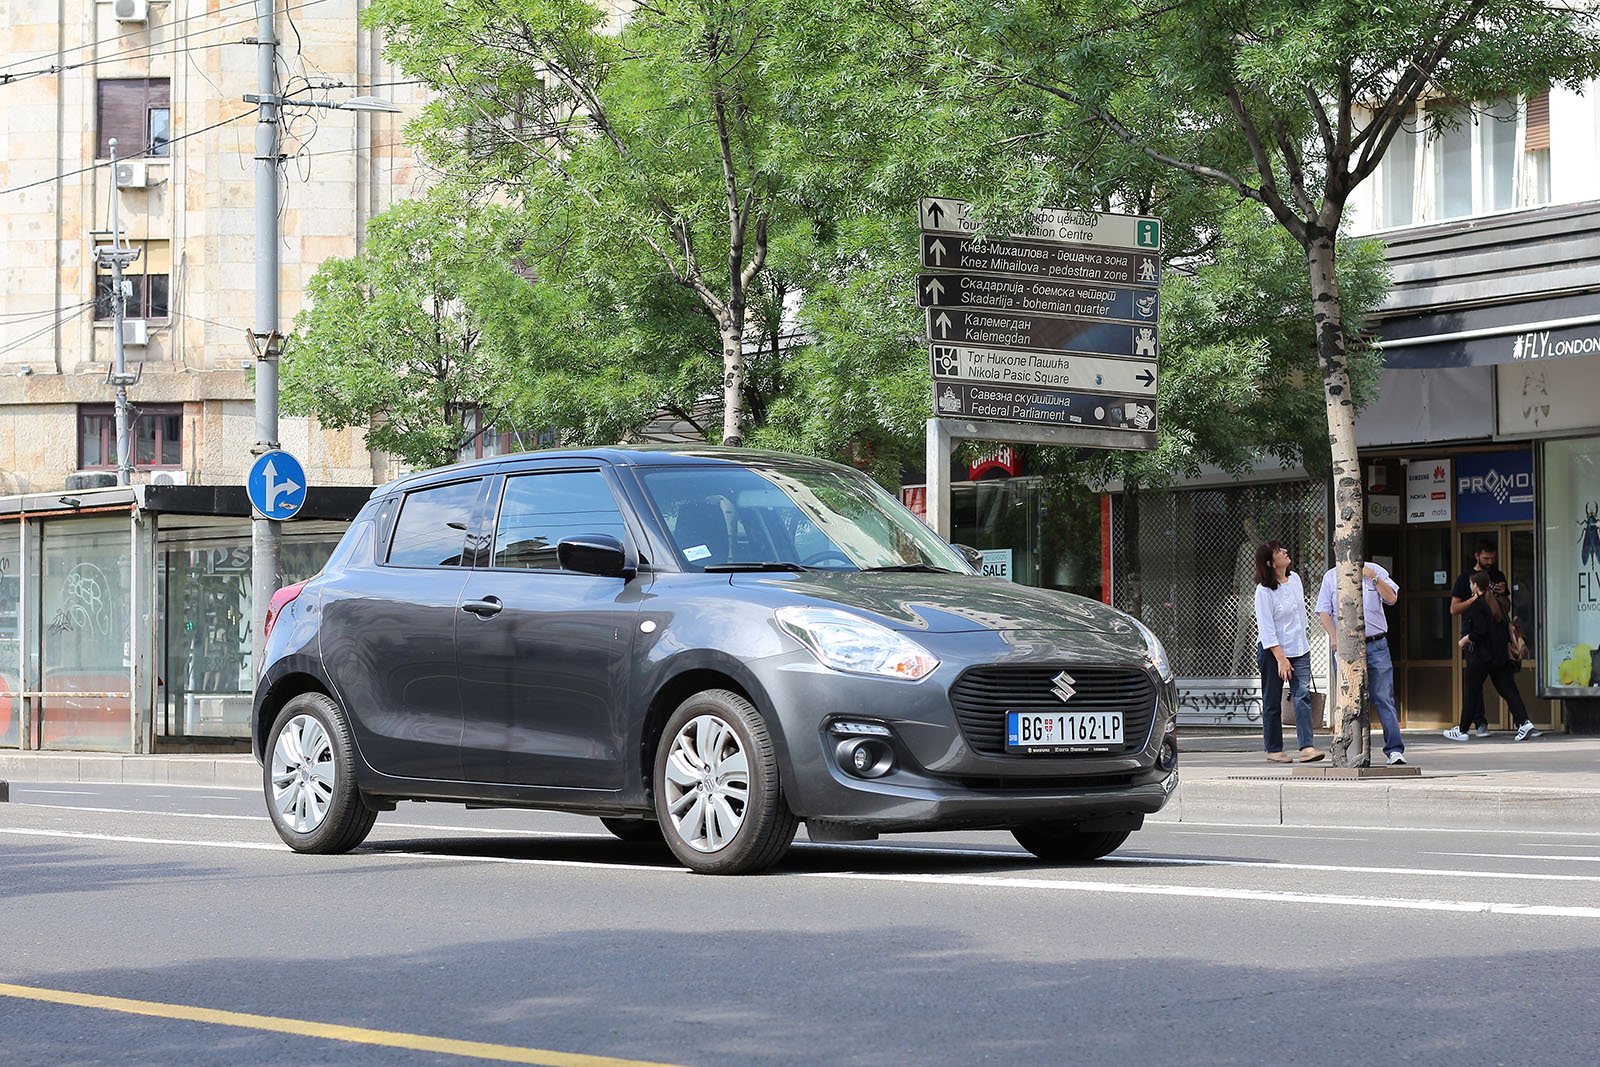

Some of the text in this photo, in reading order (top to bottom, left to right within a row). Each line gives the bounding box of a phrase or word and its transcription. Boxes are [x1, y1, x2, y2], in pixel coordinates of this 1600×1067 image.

[1059, 227, 1094, 241] Centre
[960, 256, 988, 269] Knez
[990, 258, 1039, 273] Mihailova
[1049, 265, 1101, 278] pedestrian
[1104, 270, 1128, 281] zone
[1104, 256, 1128, 267] зона
[960, 277, 1024, 294] Скадарлија
[1032, 283, 1075, 298] боемска
[961, 292, 1013, 309] Skadarlija
[1023, 297, 1072, 312] bohemian
[1074, 304, 1110, 316] quarter
[964, 313, 1031, 331] Калемегдан
[965, 328, 1031, 345] Kalemegdan
[1523, 330, 1600, 359] FLY LONDON
[968, 351, 1069, 369] Трг Николе Пашића
[968, 366, 1070, 385] Nikola Pasic Square
[970, 387, 1013, 402] Савезна
[971, 402, 1010, 416] Federal
[1012, 405, 1065, 421] Parliament
[1458, 470, 1533, 494] PROMO
[983, 564, 1006, 576] SALE
[1022, 717, 1042, 741] BG
